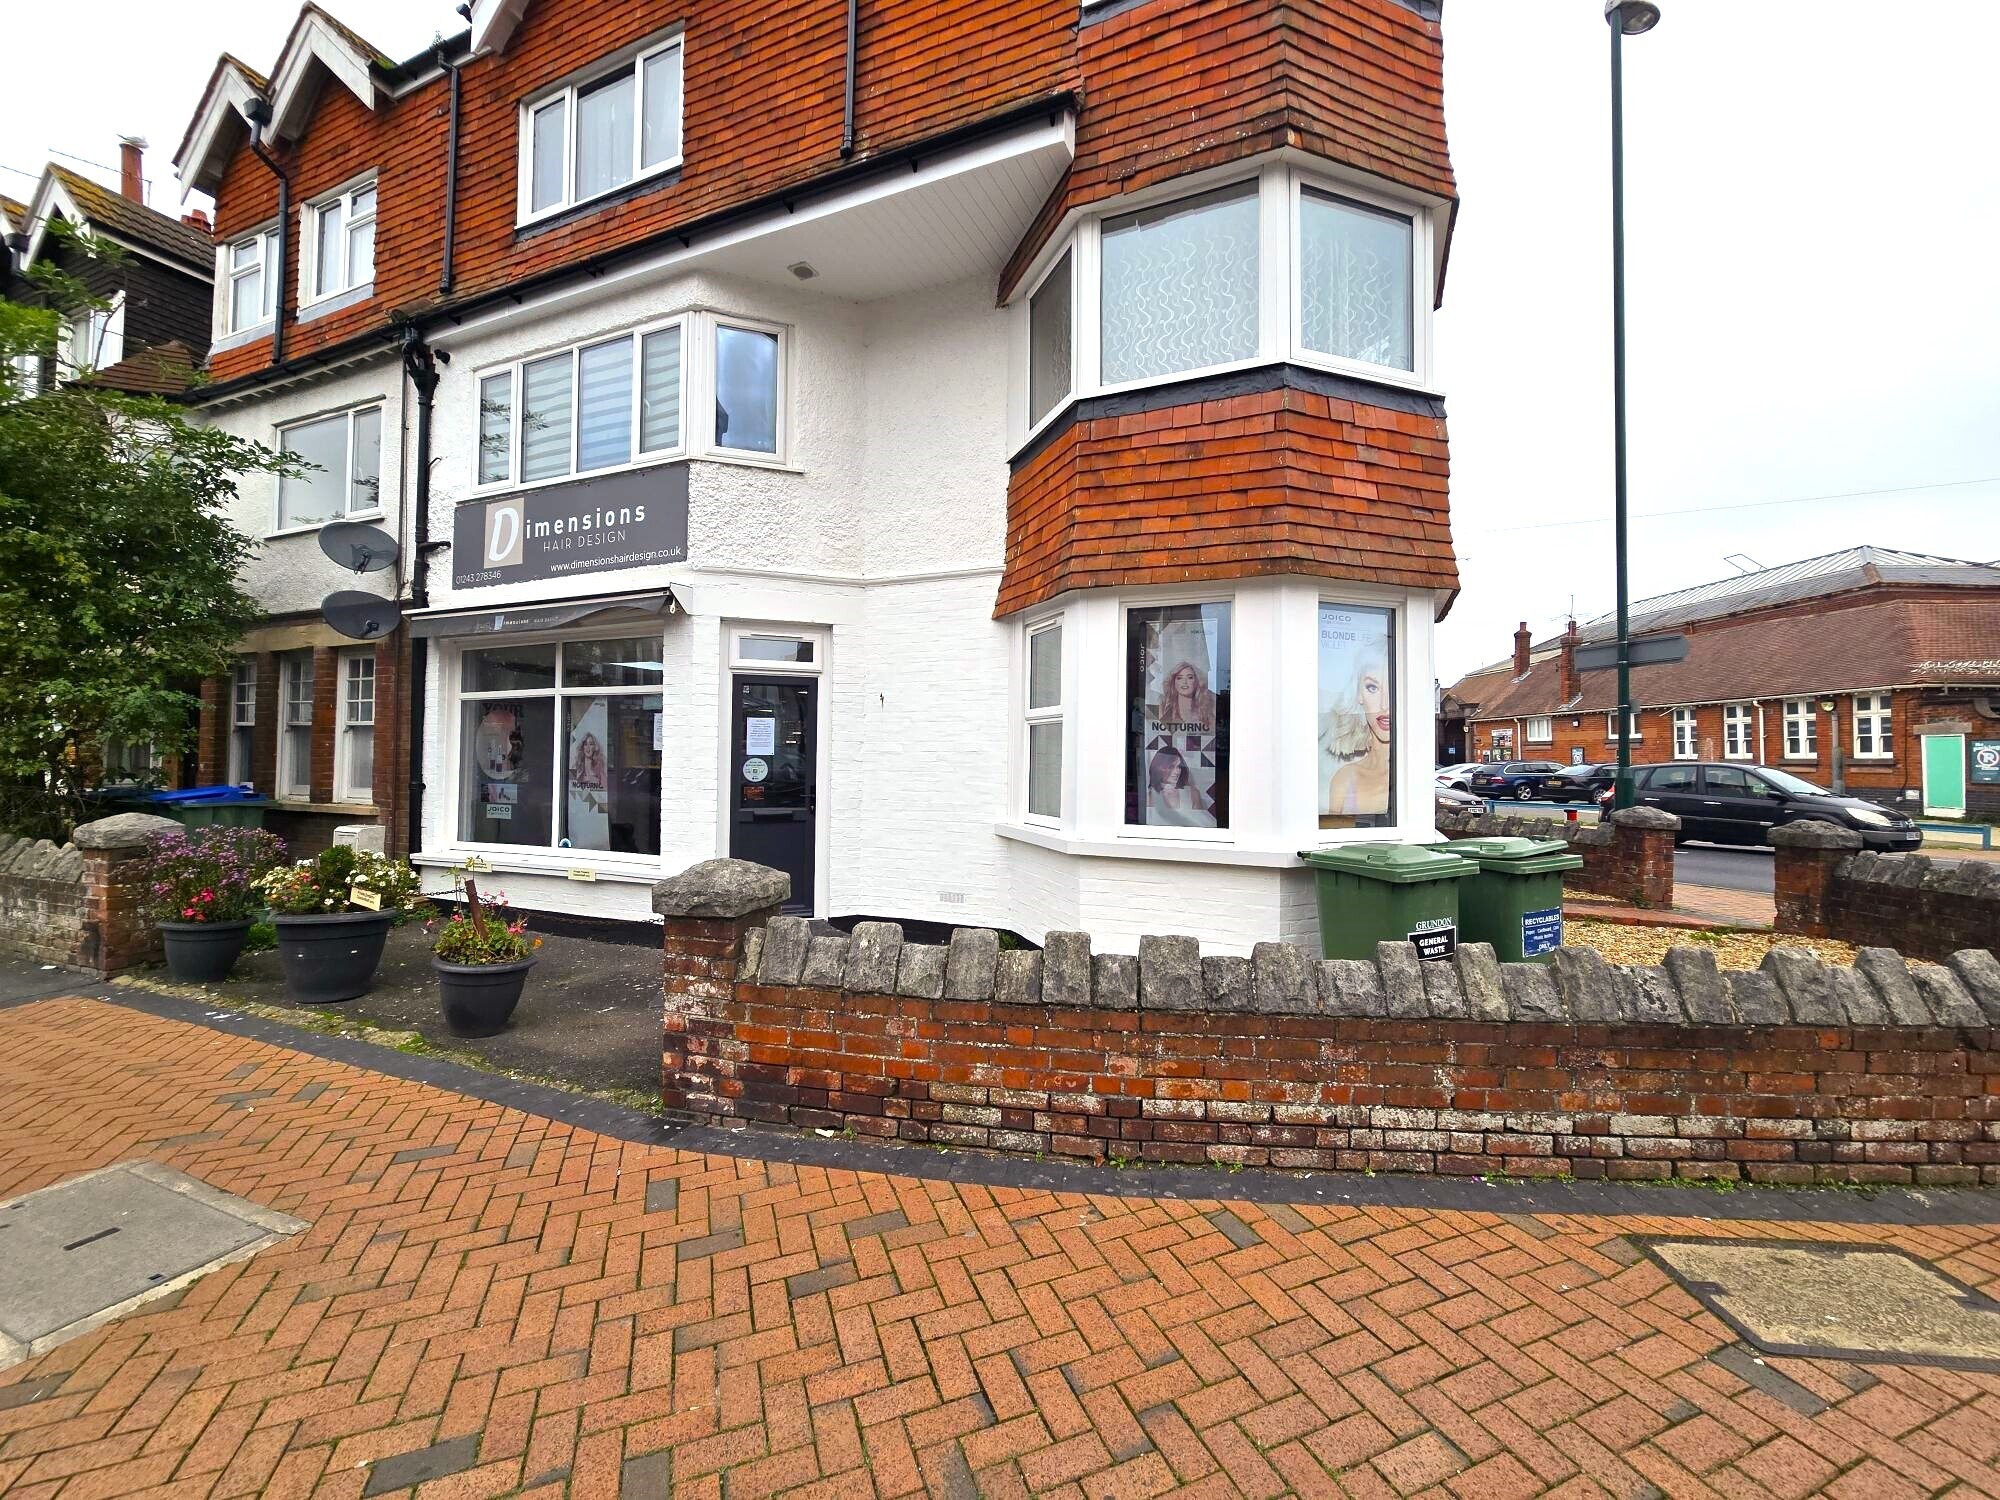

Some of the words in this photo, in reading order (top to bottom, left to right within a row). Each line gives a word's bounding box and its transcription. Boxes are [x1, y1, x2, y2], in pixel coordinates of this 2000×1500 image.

[488, 505, 645, 561] Dimensions
[543, 537, 572, 552] HAIR
[578, 529, 626, 548] DESIGN
[550, 545, 682, 572] www.dimensionshairdesign.co.uk
[455, 573, 475, 584] 01243
[475, 570, 502, 581] 278346
[1321, 630, 1356, 641] BLONDE
[1151, 721, 1210, 732] NOTTURNO
[1415, 917, 1452, 930] GRUNDON
[1525, 914, 1559, 925] RECYCLABLES
[1419, 935, 1448, 947] GENERAL
[1423, 945, 1446, 956] WASTE
